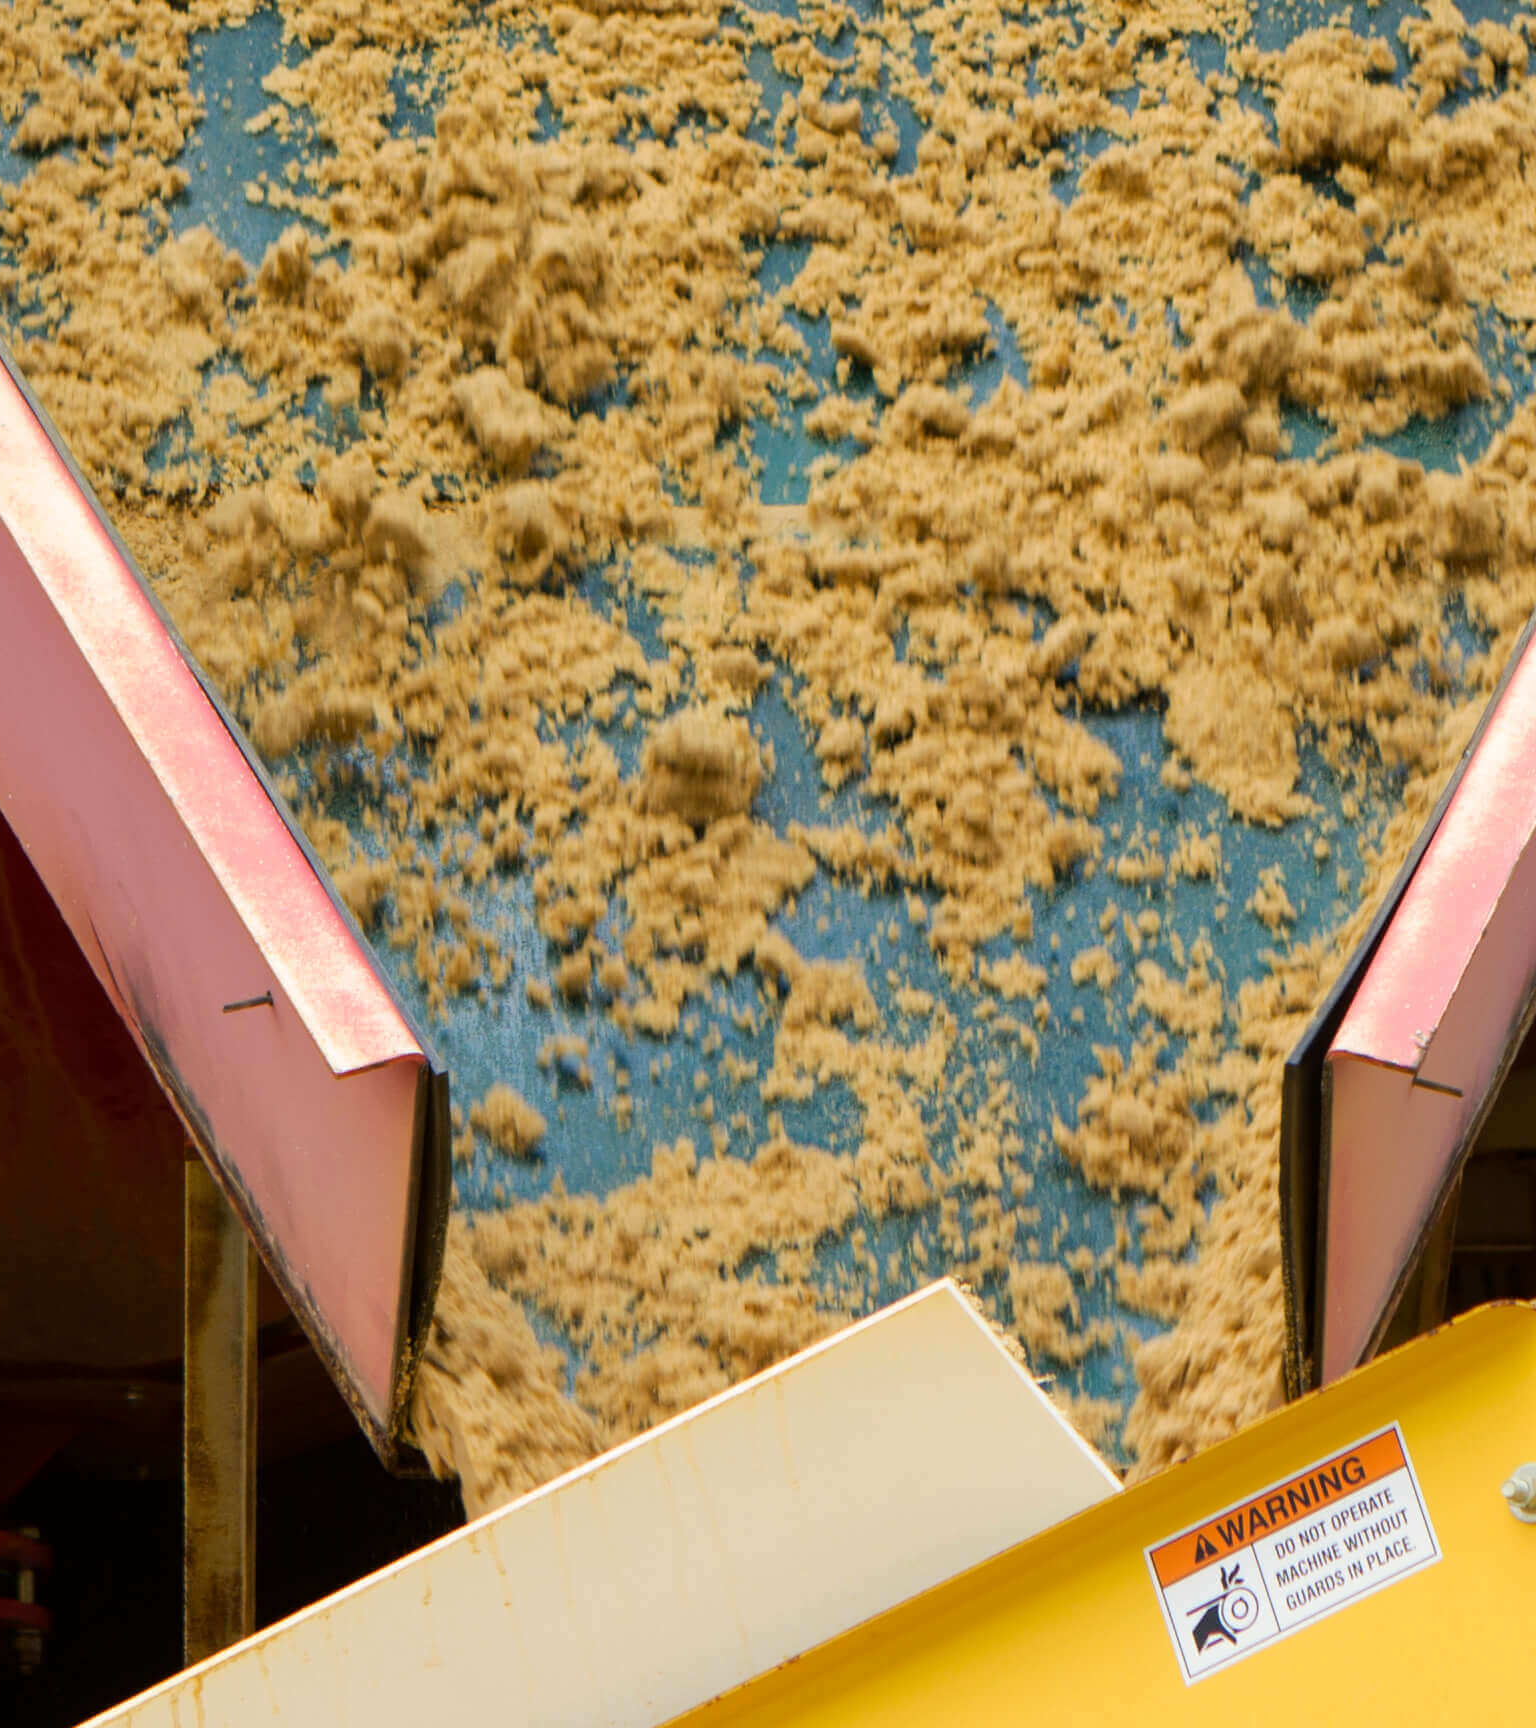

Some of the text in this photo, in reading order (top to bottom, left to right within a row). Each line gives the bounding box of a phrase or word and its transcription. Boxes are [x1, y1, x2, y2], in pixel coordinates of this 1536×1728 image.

[1216, 1456, 1366, 1547] WARNING
[1274, 1487, 1395, 1560] DO NOT OPERATE
[1275, 1507, 1409, 1588] MACHINE WITHOUT
[1285, 1569, 1346, 1611] GUARDS
[1347, 1559, 1364, 1580] IN
